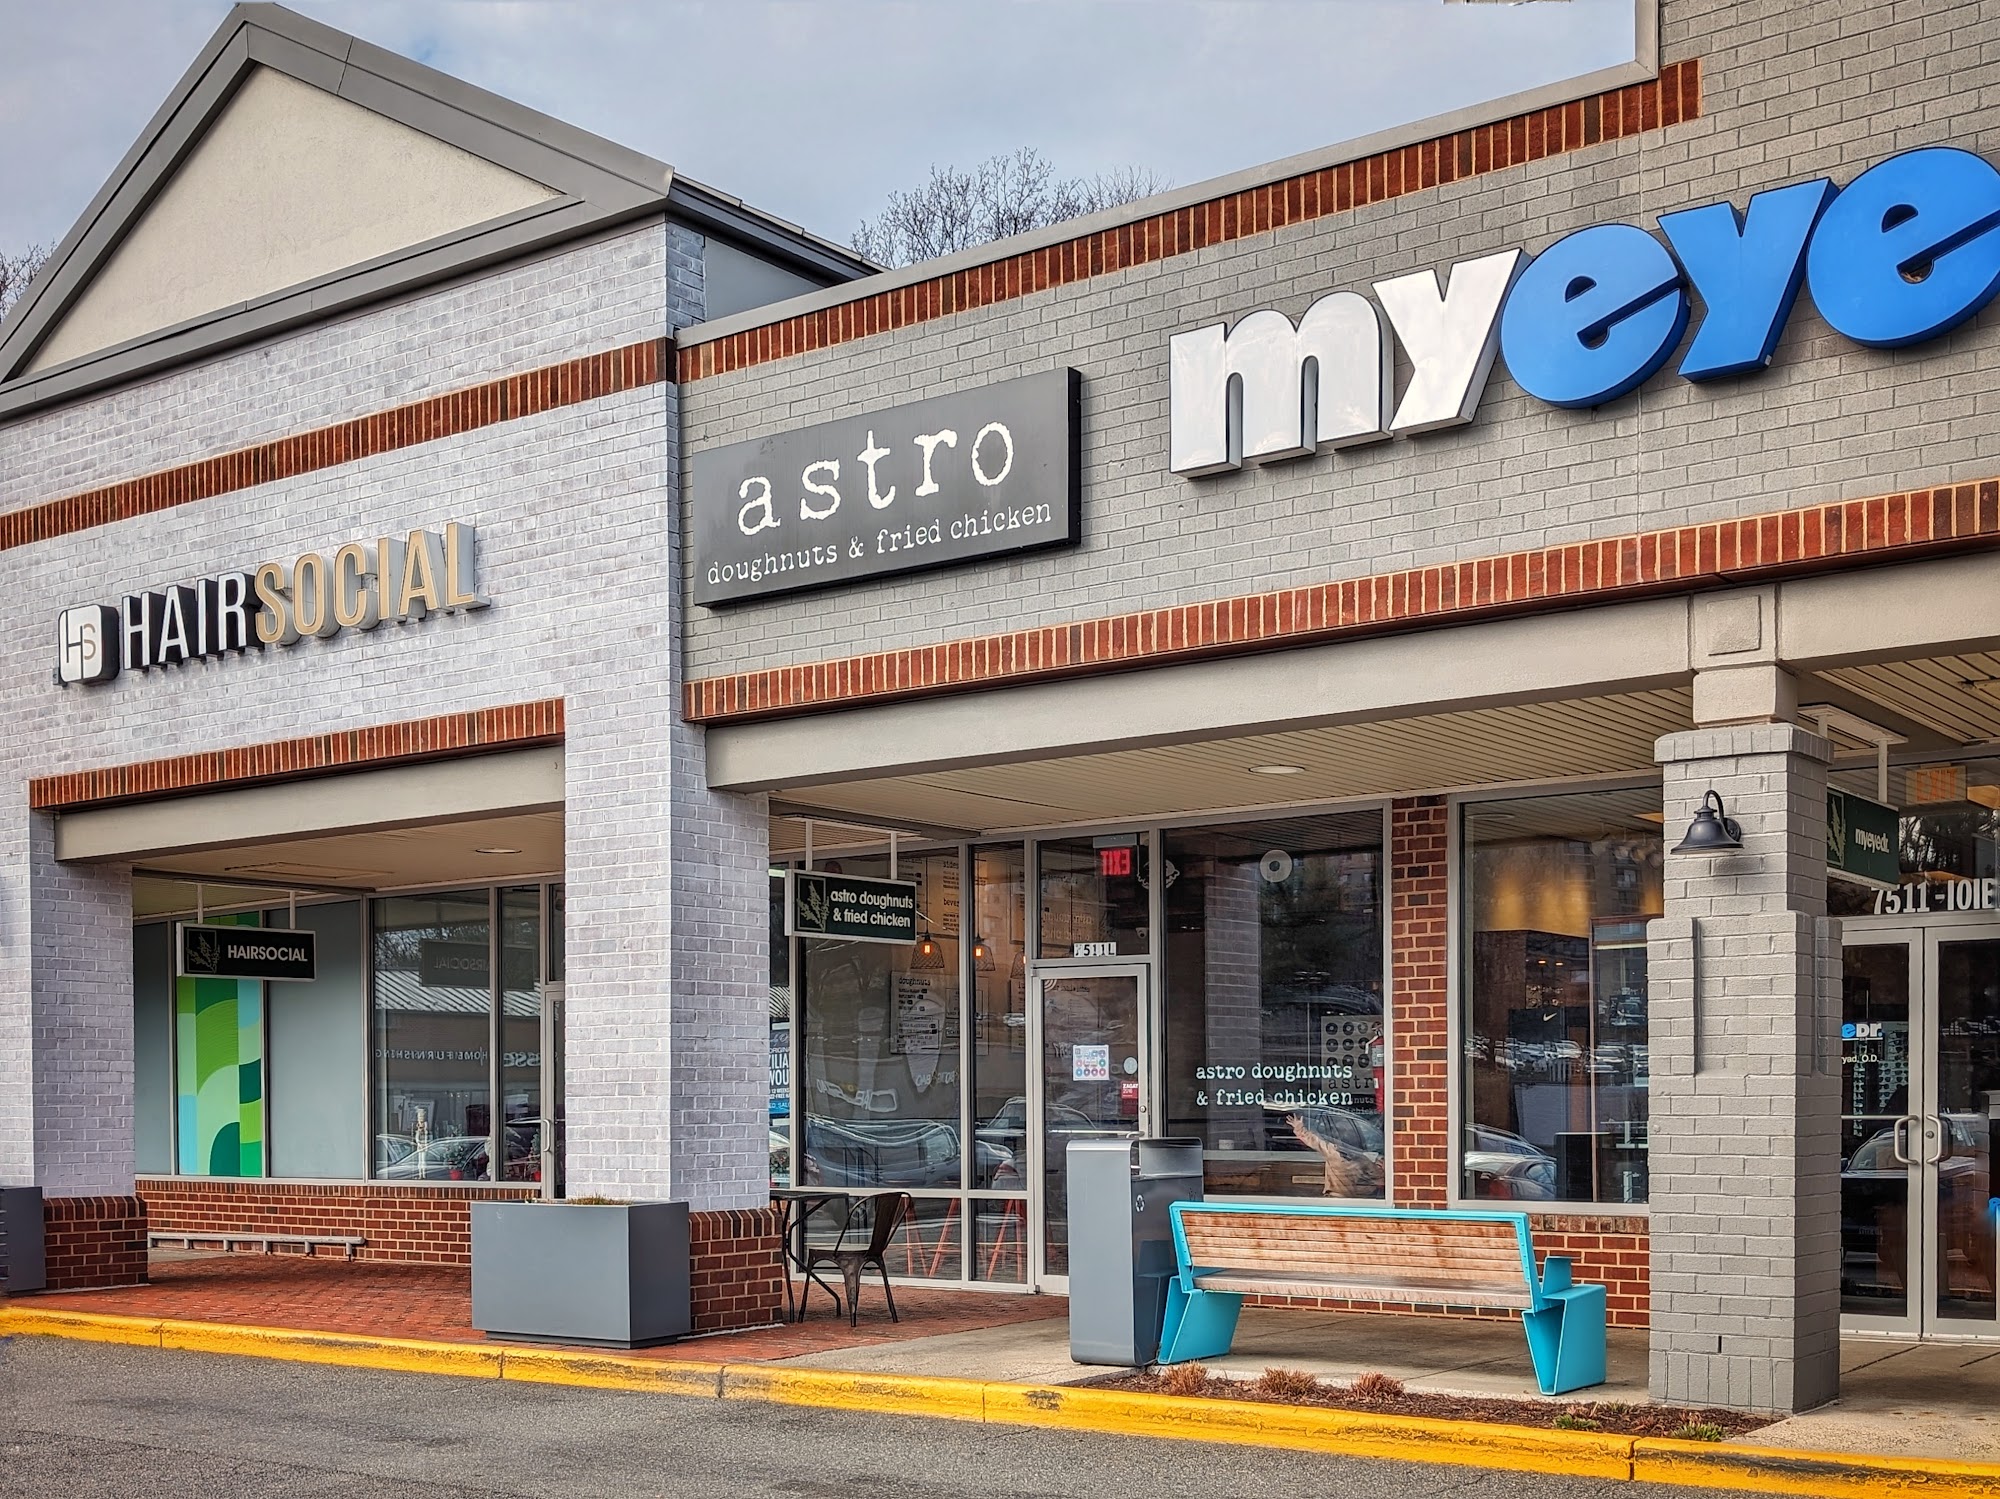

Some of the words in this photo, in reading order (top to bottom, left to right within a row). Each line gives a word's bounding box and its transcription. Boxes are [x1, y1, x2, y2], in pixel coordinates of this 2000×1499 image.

[737, 421, 1016, 537] astro
[706, 542, 838, 586] doughnuts
[848, 536, 864, 559] &
[876, 519, 943, 555] fried
[949, 501, 1053, 541] chicken
[119, 521, 485, 670] HAIRSOCIAL
[1916, 768, 1958, 801] EXIT
[830, 889, 857, 904] astro
[859, 891, 913, 910] doughnuts
[833, 908, 842, 922] &
[844, 909, 868, 924] fried
[870, 910, 911, 928] chicken
[227, 944, 308, 963] HAIRSOCIAL
[1195, 1064, 1246, 1080] astro
[1251, 1063, 1353, 1082] doughnuts
[1196, 1090, 1209, 1106] &
[1216, 1089, 1265, 1106] fried
[1272, 1089, 1353, 1106] chicken
